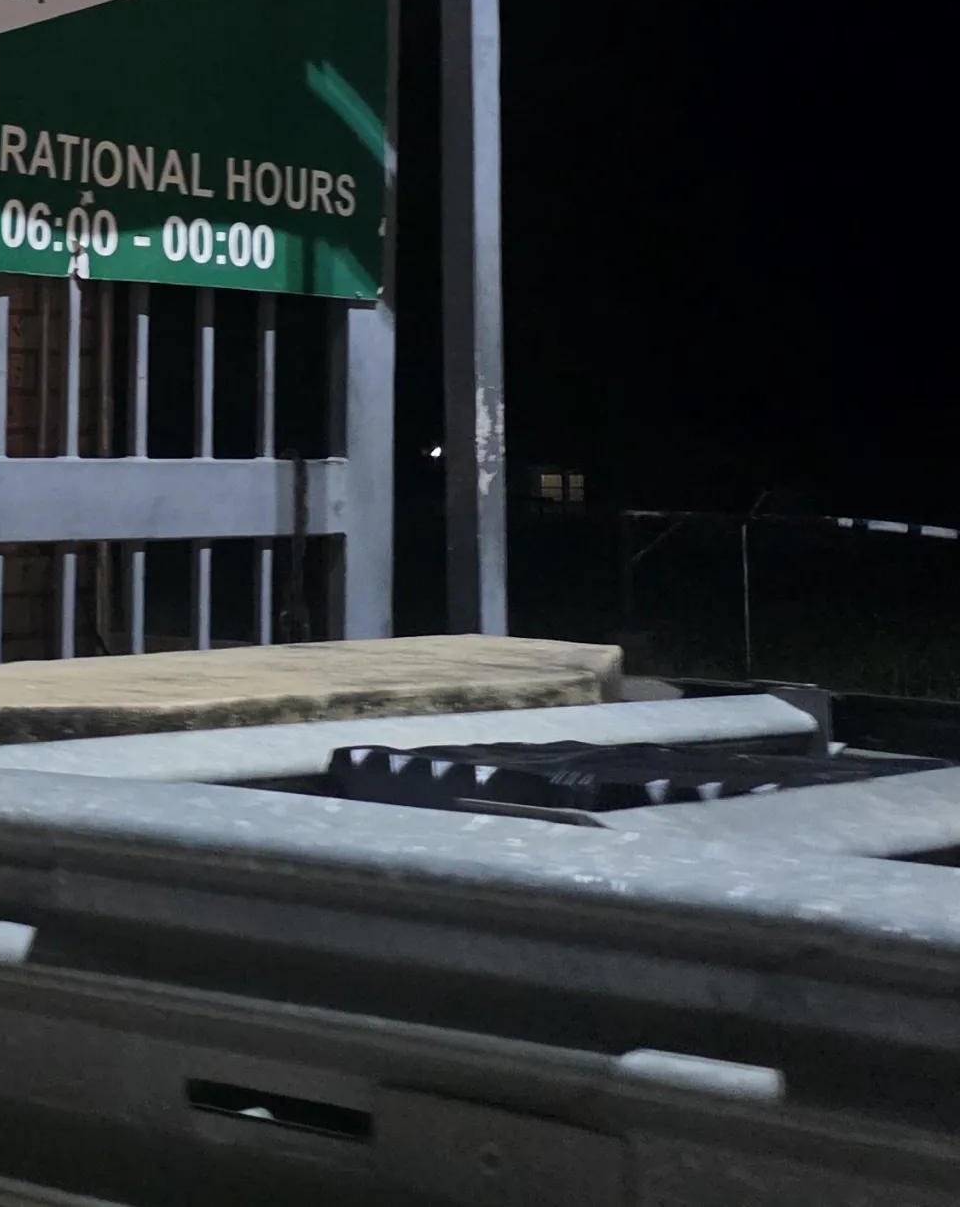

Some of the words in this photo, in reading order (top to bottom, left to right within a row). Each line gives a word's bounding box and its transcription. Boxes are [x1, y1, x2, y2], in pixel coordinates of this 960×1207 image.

[226, 156, 357, 217] HOURS
[0, 198, 119, 257] 06:00
[133, 235, 151, 247] -
[161, 215, 276, 270] 00:00
